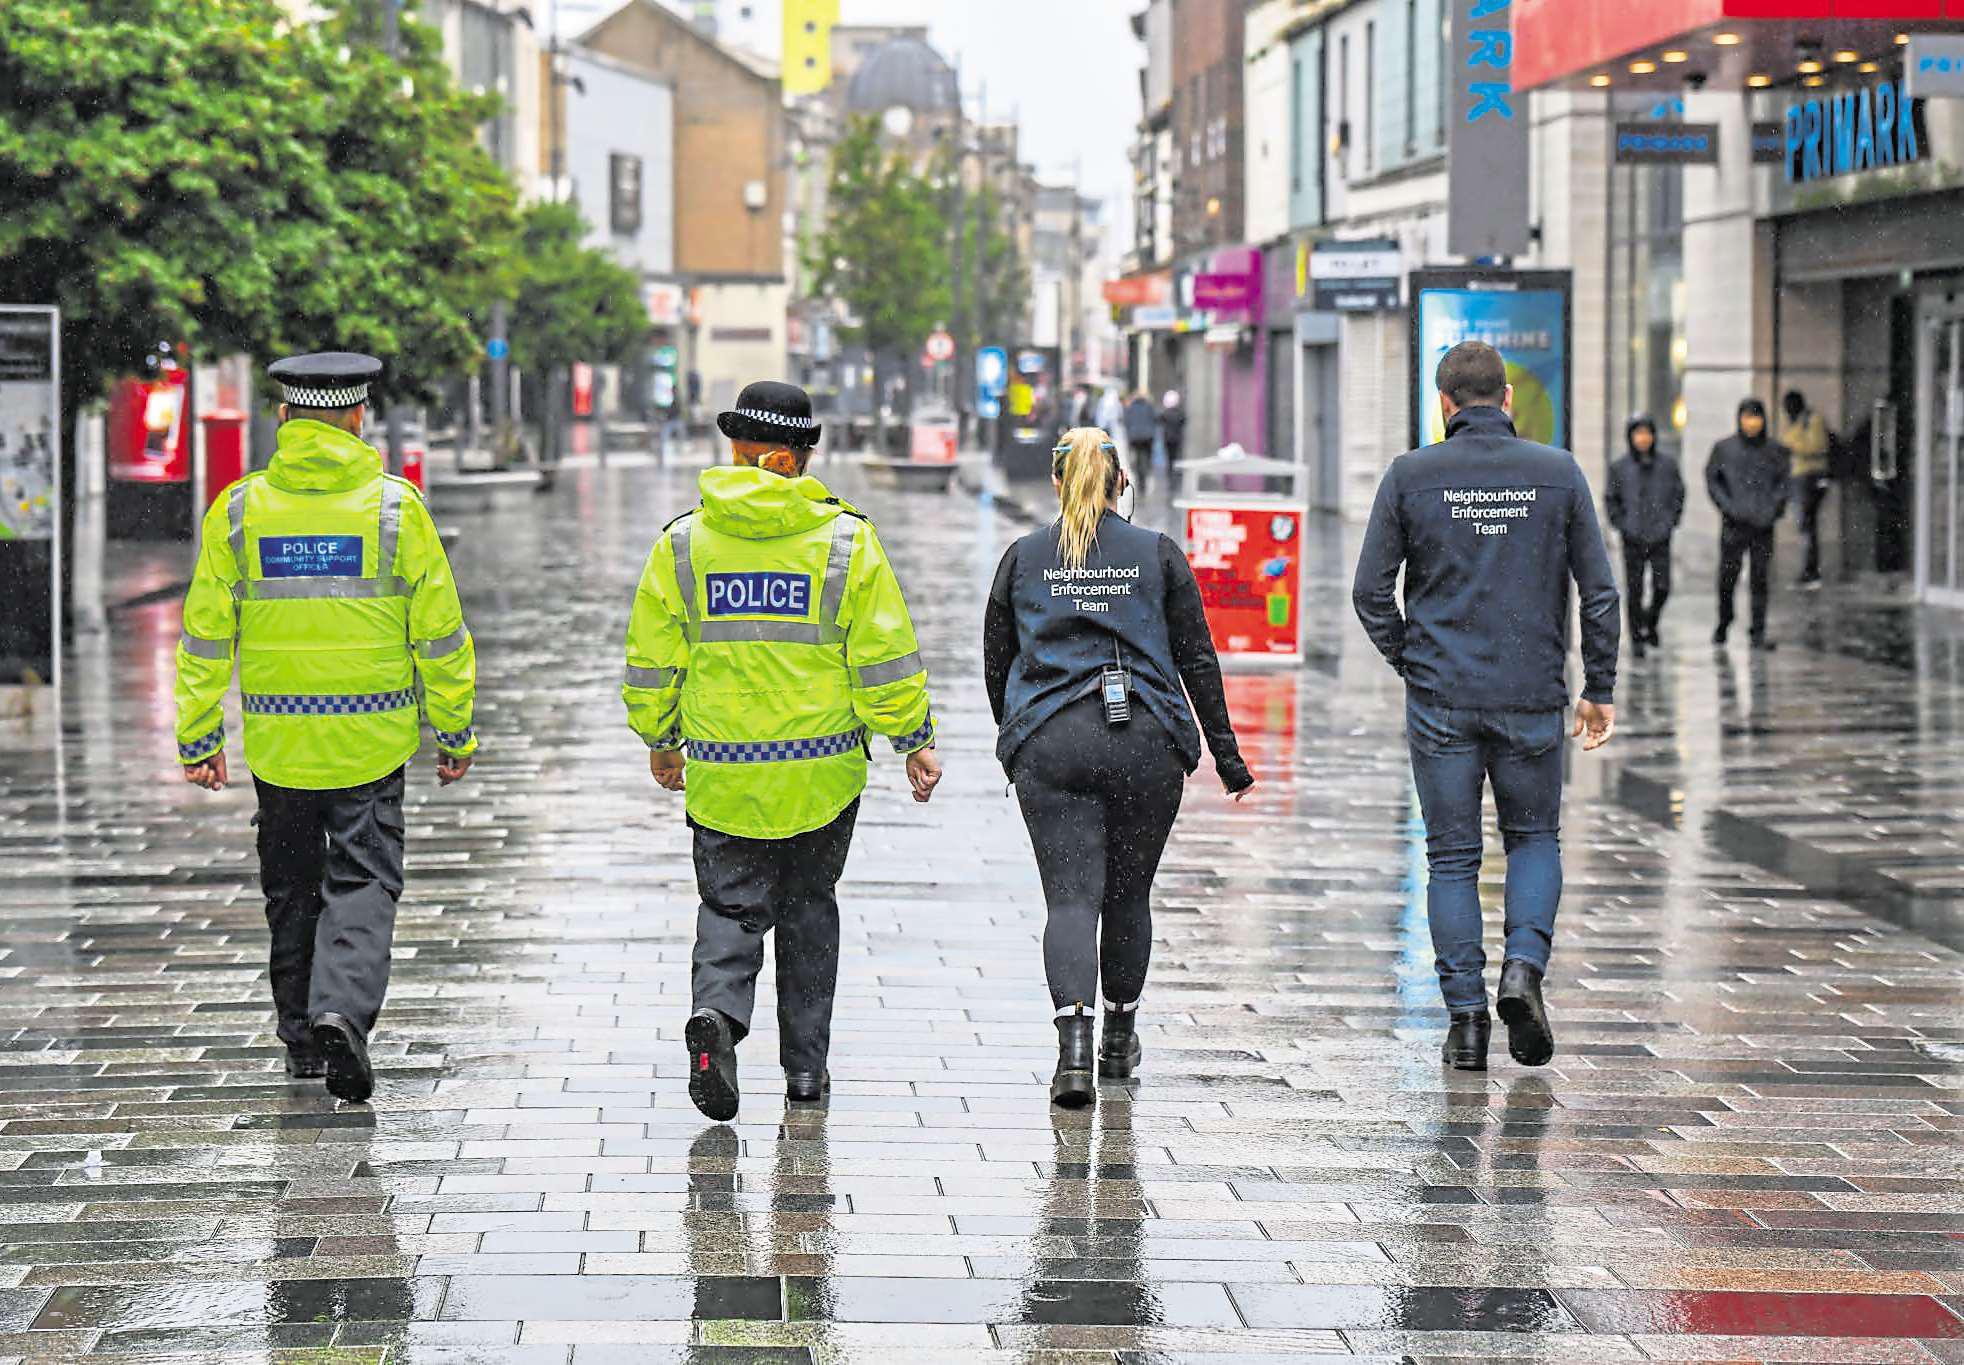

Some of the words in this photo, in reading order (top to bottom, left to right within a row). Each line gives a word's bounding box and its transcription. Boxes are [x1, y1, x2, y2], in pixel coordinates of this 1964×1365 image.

[1785, 80, 1918, 184] PRIMARK
[1443, 489, 1537, 504] Neighbourhood
[1451, 505, 1529, 518] Enforcement
[1472, 522, 1508, 535] Team
[282, 542, 338, 554] POLICE
[1043, 566, 1140, 581] Neighbourhood
[710, 579, 806, 609] POLICE
[1051, 583, 1131, 597] Enforcement
[1072, 599, 1109, 612] Team
